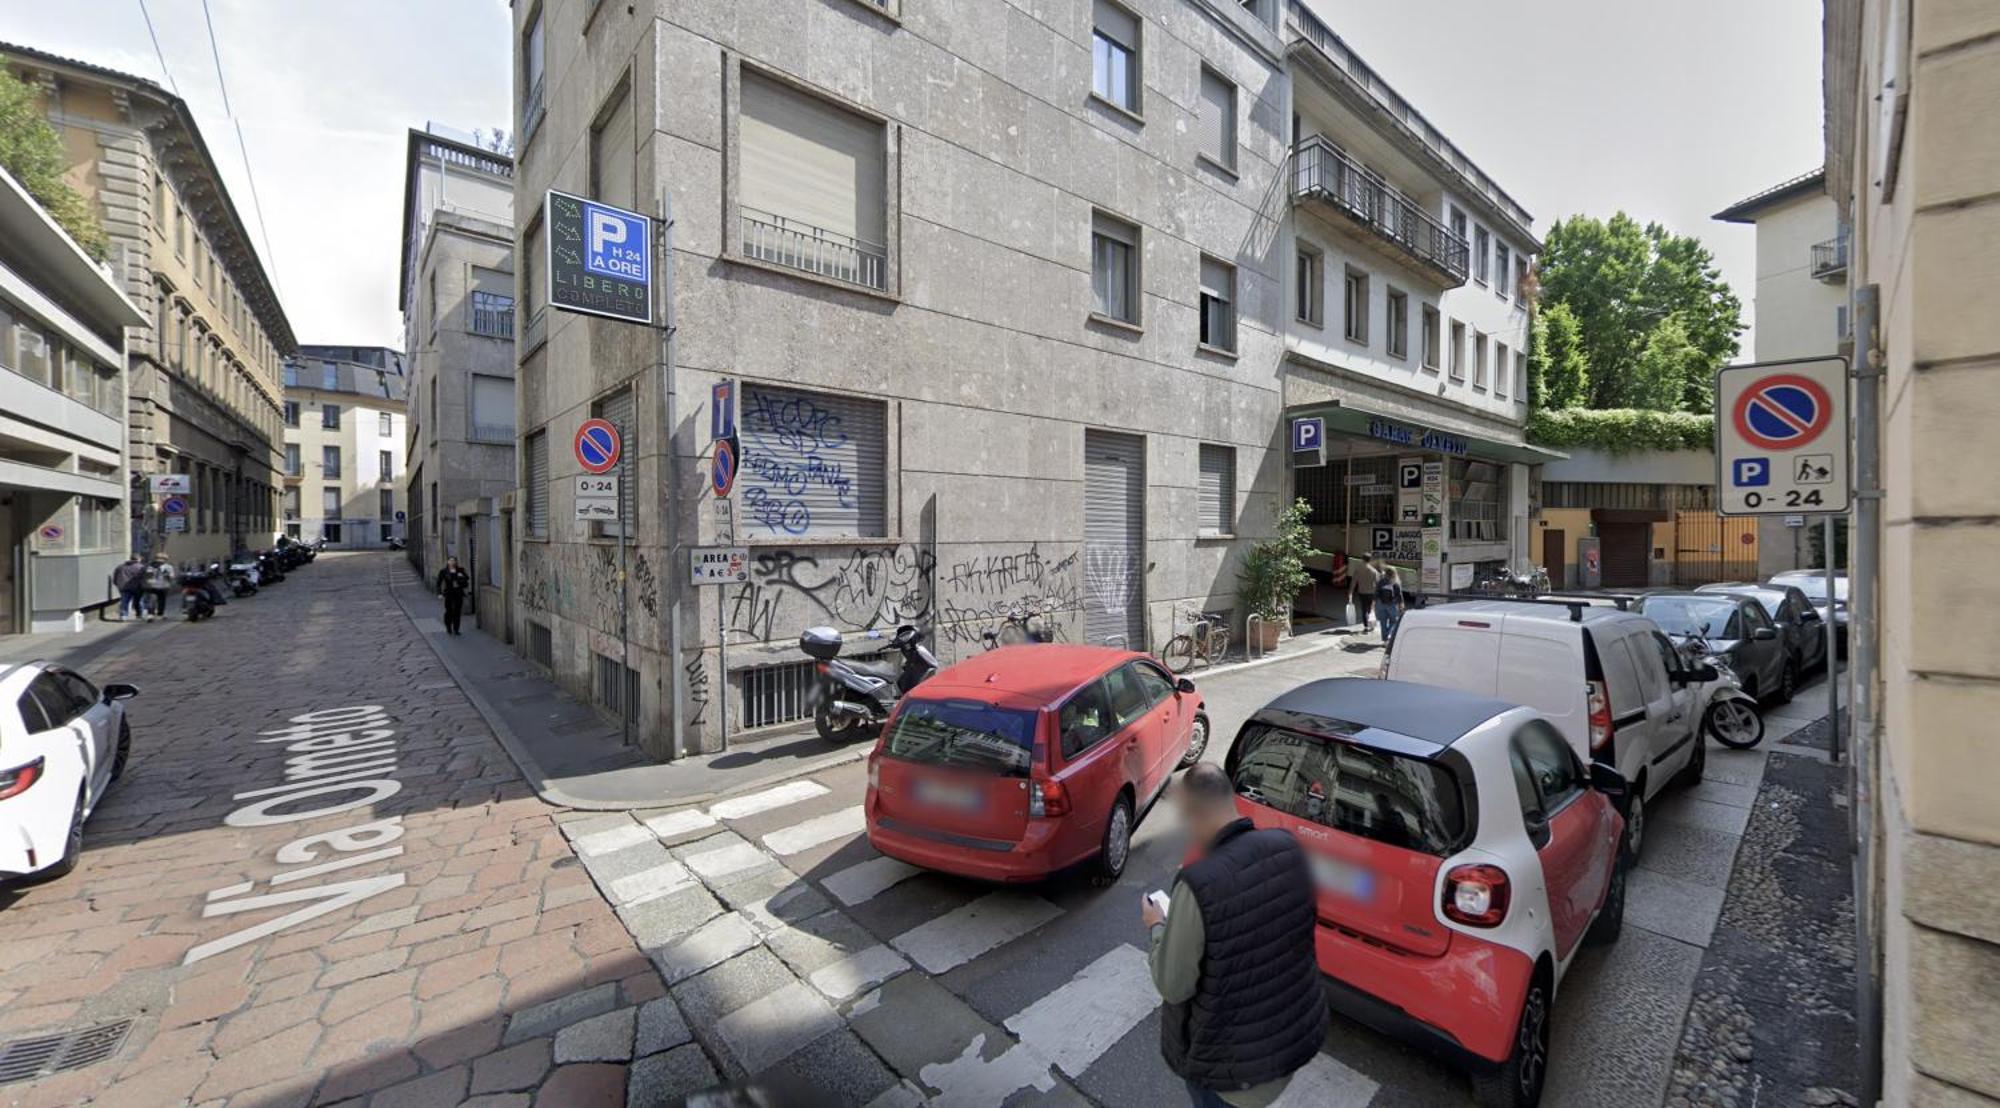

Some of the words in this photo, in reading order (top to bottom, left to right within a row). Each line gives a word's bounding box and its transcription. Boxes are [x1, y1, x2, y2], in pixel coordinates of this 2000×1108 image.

[591, 211, 627, 254] P
[612, 247, 623, 259] H
[625, 250, 642, 262] 24
[593, 255, 606, 268] A
[608, 258, 642, 277] ORE
[556, 270, 645, 300] LIBERO
[1300, 425, 1315, 445] P
[1403, 467, 1419, 487] P
[1740, 462, 1763, 483] P
[1375, 530, 1389, 548] P
[703, 554, 728, 563] AREA
[223, 704, 403, 828] Olmetto
[1298, 825, 1329, 841] smart
[182, 814, 406, 967] Via
